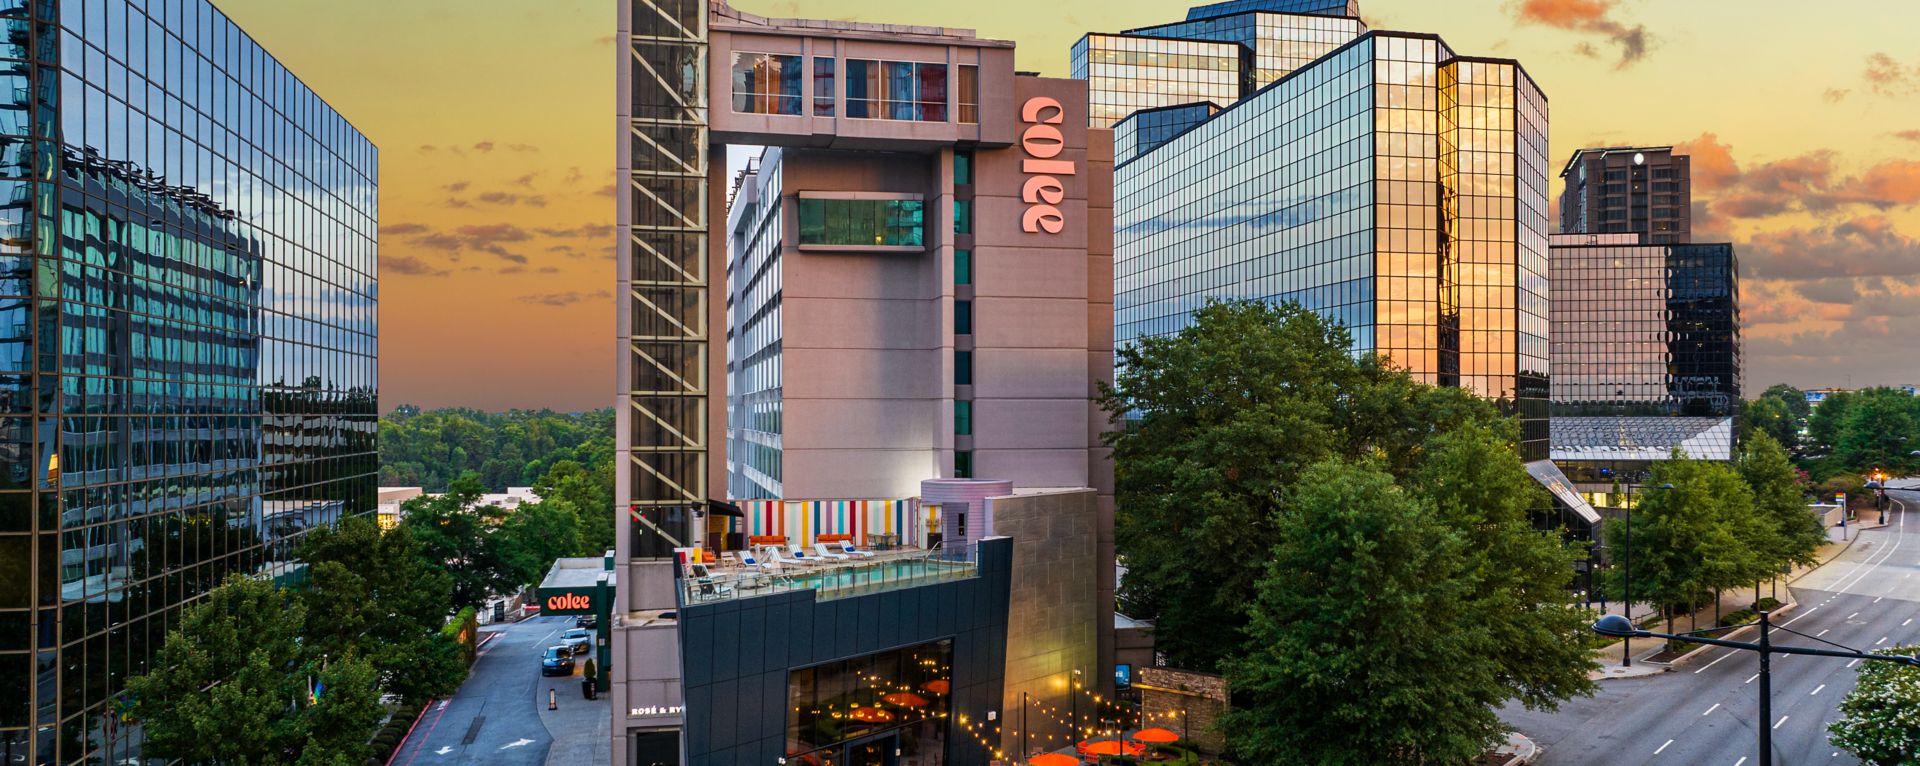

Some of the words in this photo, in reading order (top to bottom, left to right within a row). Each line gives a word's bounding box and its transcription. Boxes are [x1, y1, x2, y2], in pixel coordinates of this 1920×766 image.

[1022, 96, 1076, 234] colee
[548, 592, 590, 610] colee
[631, 705, 657, 716] ROSÉ
